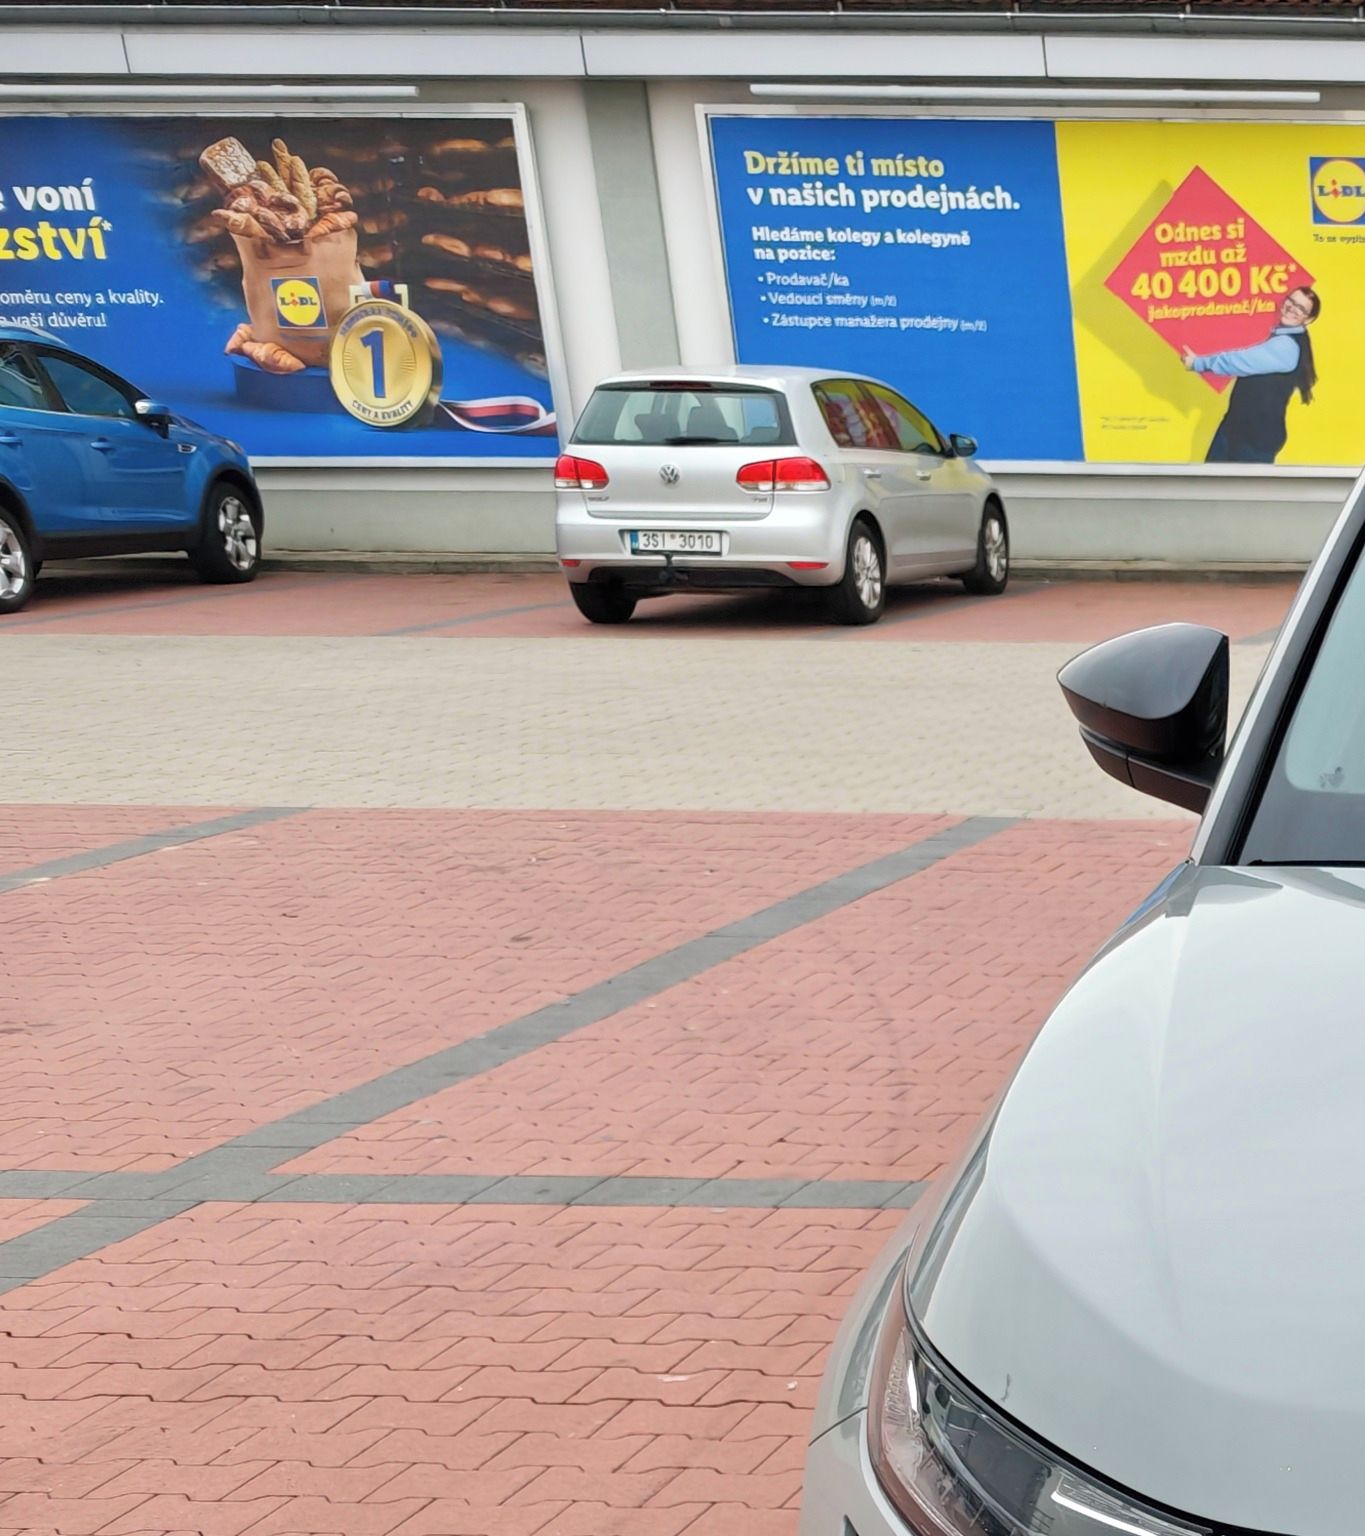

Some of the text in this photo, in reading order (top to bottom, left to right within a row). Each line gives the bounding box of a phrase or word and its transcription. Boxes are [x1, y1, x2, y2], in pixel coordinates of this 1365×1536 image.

[744, 150, 945, 178] Držíme ti místo
[13, 177, 96, 211] voní
[746, 181, 1021, 215] v našich prodejnách.
[752, 226, 971, 248] Hledáme kolegy a kolegyně
[1155, 217, 1245, 244] Odnes si
[754, 245, 836, 263] na pozice:
[1160, 242, 1247, 267] mzdu až
[766, 271, 850, 288] Prodavač/ka
[1131, 271, 1174, 300] 40
[1178, 266, 1242, 298] 400
[55, 292, 92, 308] ceny
[95, 292, 106, 304] a
[108, 289, 164, 308] kvality.
[279, 292, 318, 307] LIDL
[826, 292, 868, 309] směny
[10, 312, 45, 328] vaši
[48, 311, 107, 328] důvěru!
[771, 313, 832, 329] Zástupce
[835, 314, 898, 329] manažera
[899, 314, 959, 332] prodejny
[360, 330, 387, 398] 1
[679, 533, 714, 549] 3010
